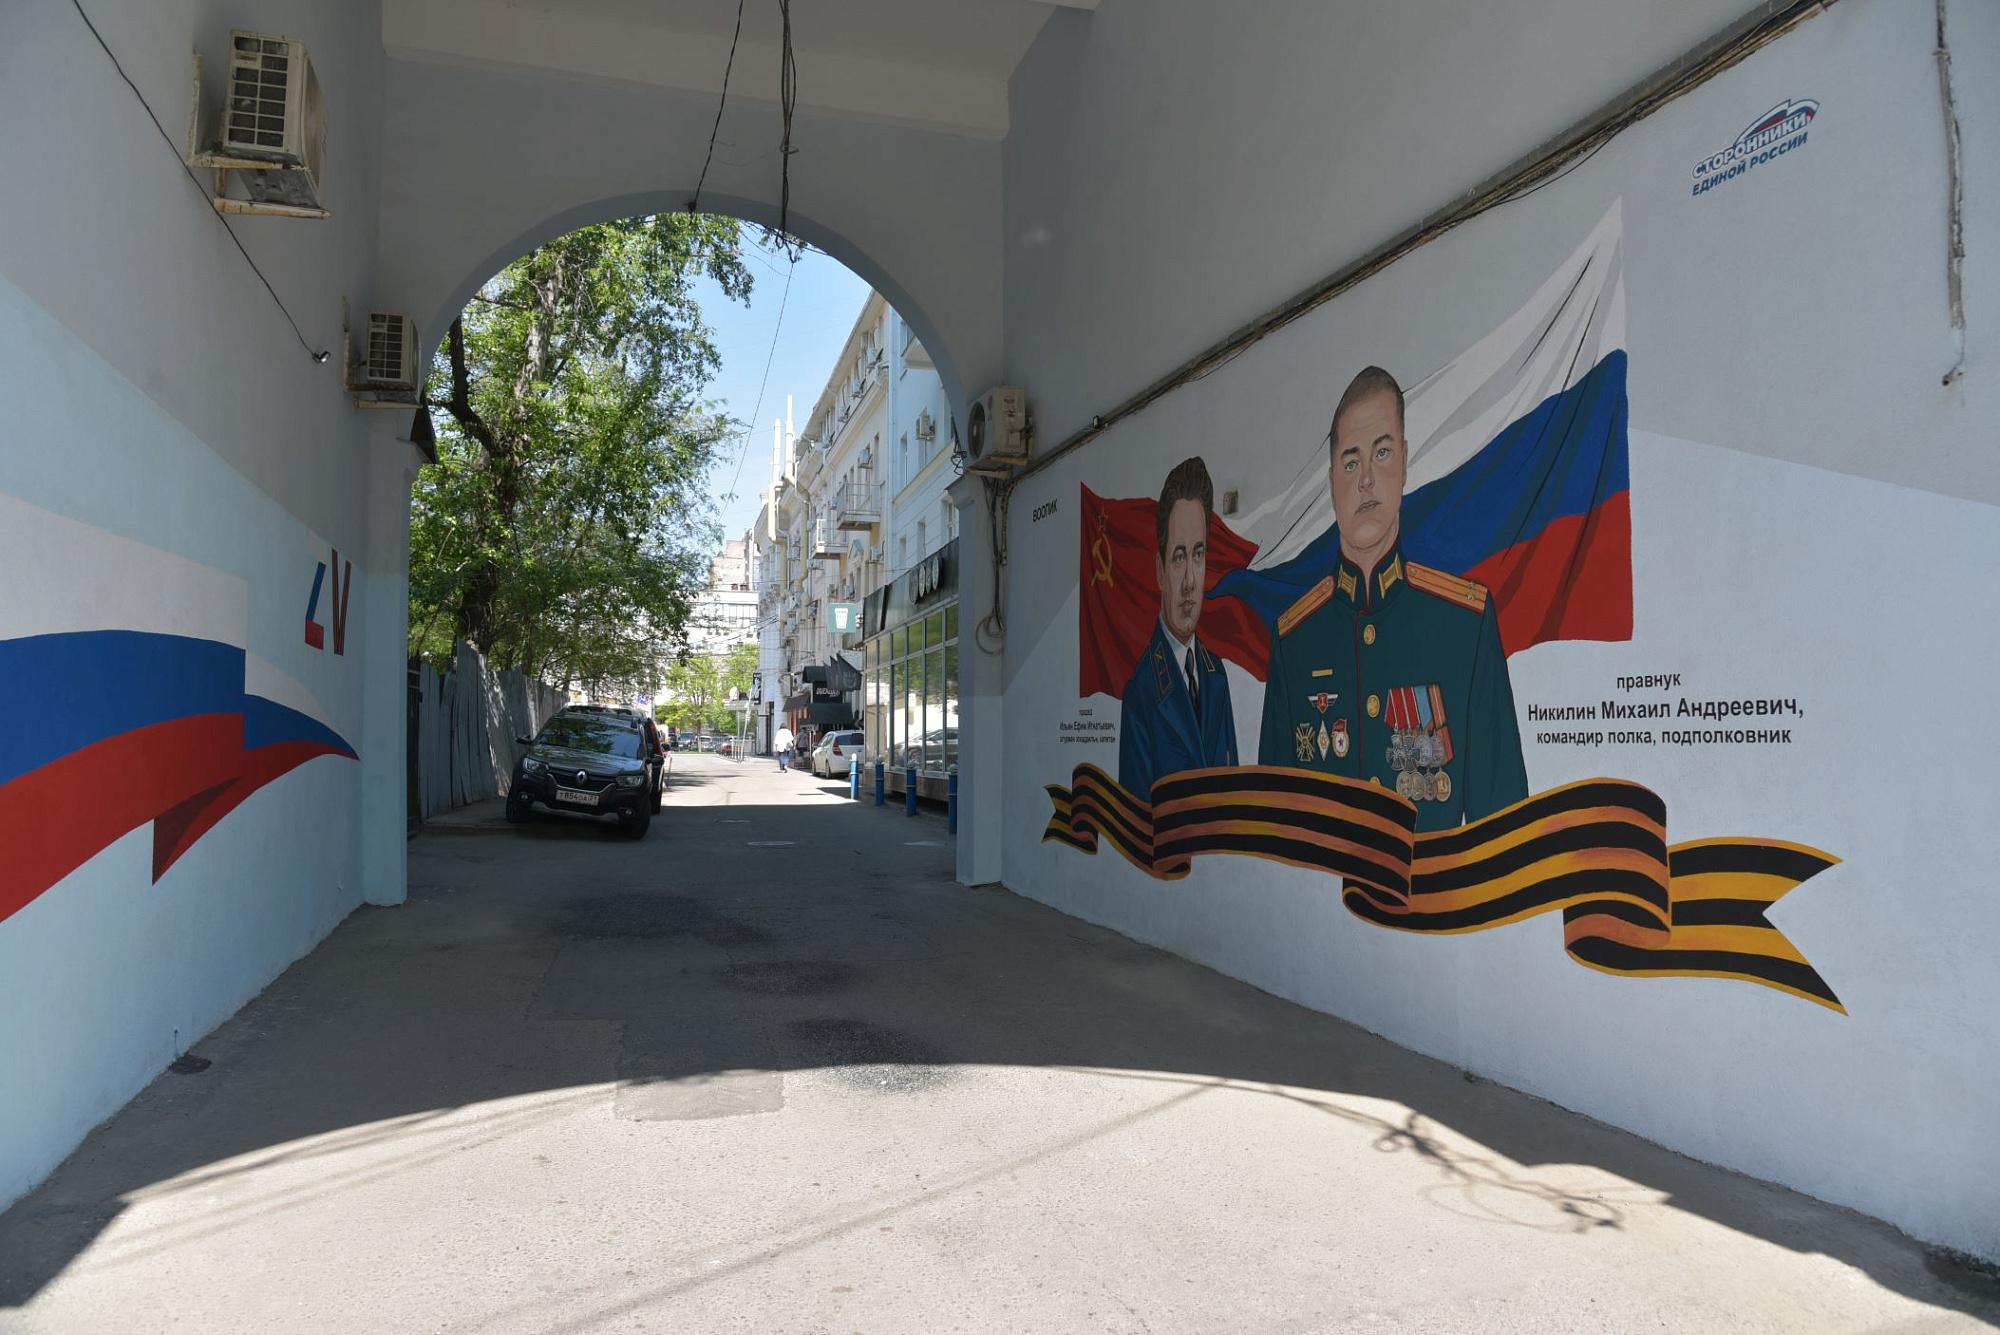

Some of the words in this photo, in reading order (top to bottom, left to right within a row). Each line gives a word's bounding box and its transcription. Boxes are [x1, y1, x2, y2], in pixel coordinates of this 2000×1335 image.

[1692, 160, 1747, 196] ЕДИНОЙ
[1750, 132, 1809, 168] РОССИИ
[1616, 673, 1682, 692] правнук
[1528, 704, 1597, 721] Никилин
[1601, 701, 1671, 719] Михаил
[1676, 698, 1804, 721] Андреевич,
[1537, 730, 1604, 747] командир
[1608, 730, 1657, 746] полка,
[1661, 729, 1792, 745] подполковник
